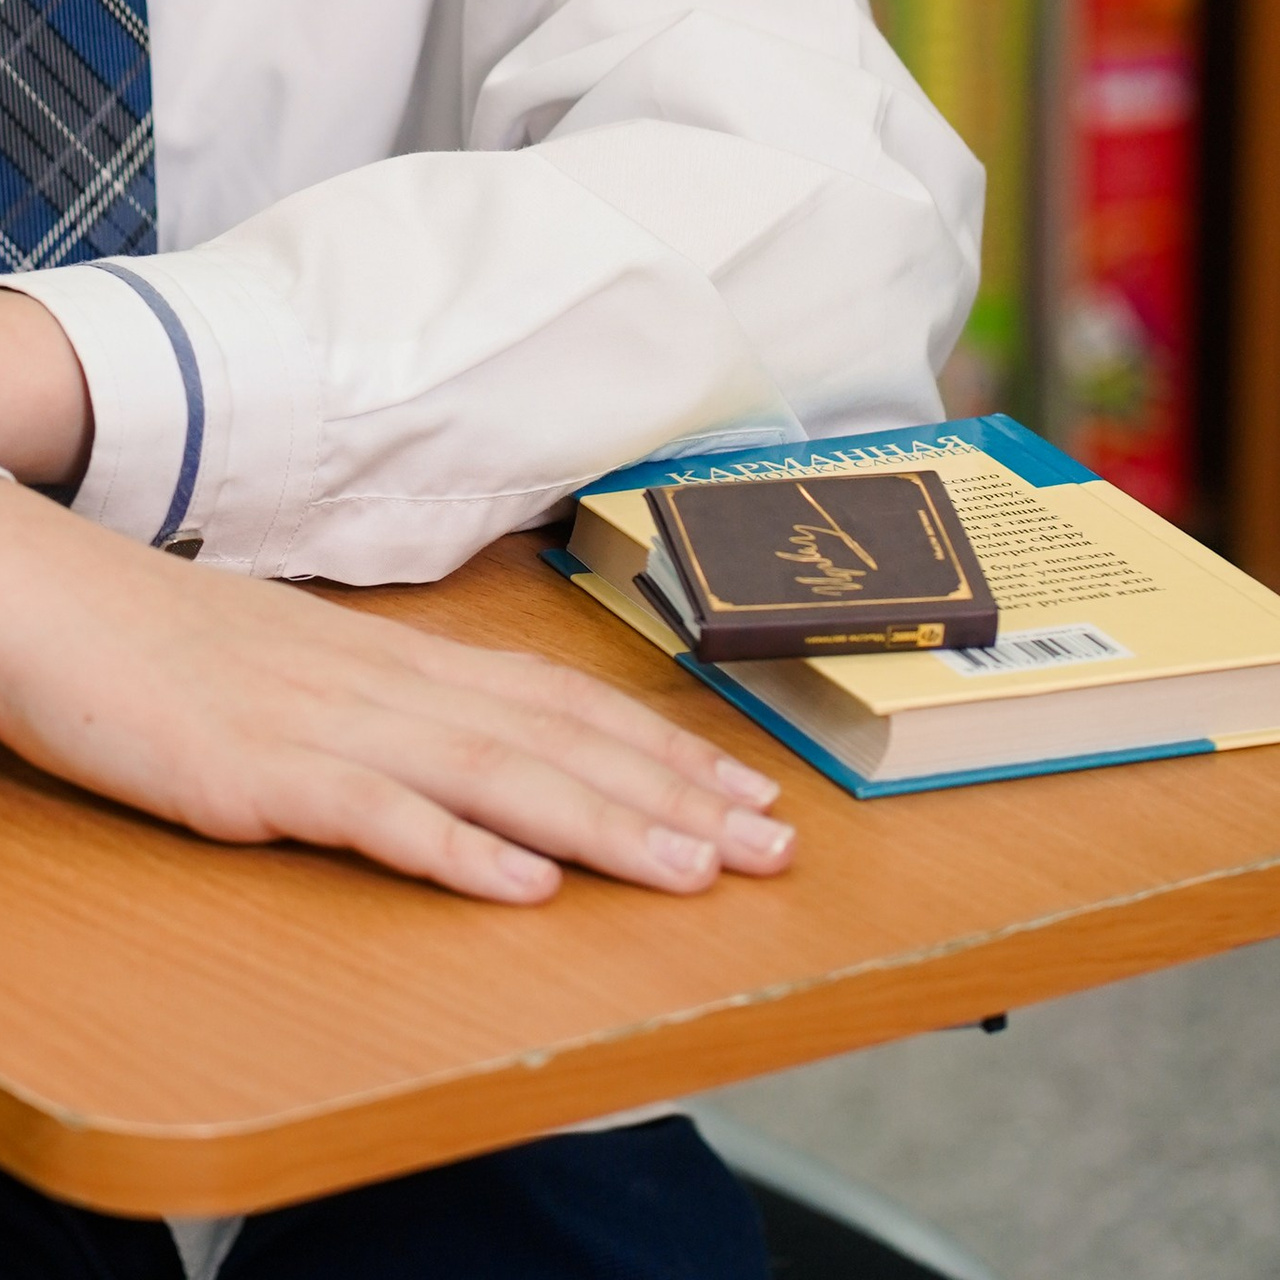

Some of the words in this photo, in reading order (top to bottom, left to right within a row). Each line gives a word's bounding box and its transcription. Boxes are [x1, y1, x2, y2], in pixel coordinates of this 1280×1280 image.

[665, 434, 975, 485] КАРМАННАЯ
[942, 472, 1000, 486] сского
[951, 481, 1012, 494] только
[961, 489, 1026, 503] корпус
[1005, 514, 1061, 526] также
[1030, 530, 1085, 544] сферу
[989, 560, 1038, 573] будет
[1044, 550, 1116, 565] полезен
[1037, 560, 1129, 577] учащимся
[1122, 576, 1153, 587] кто
[1037, 592, 1111, 607] русский
